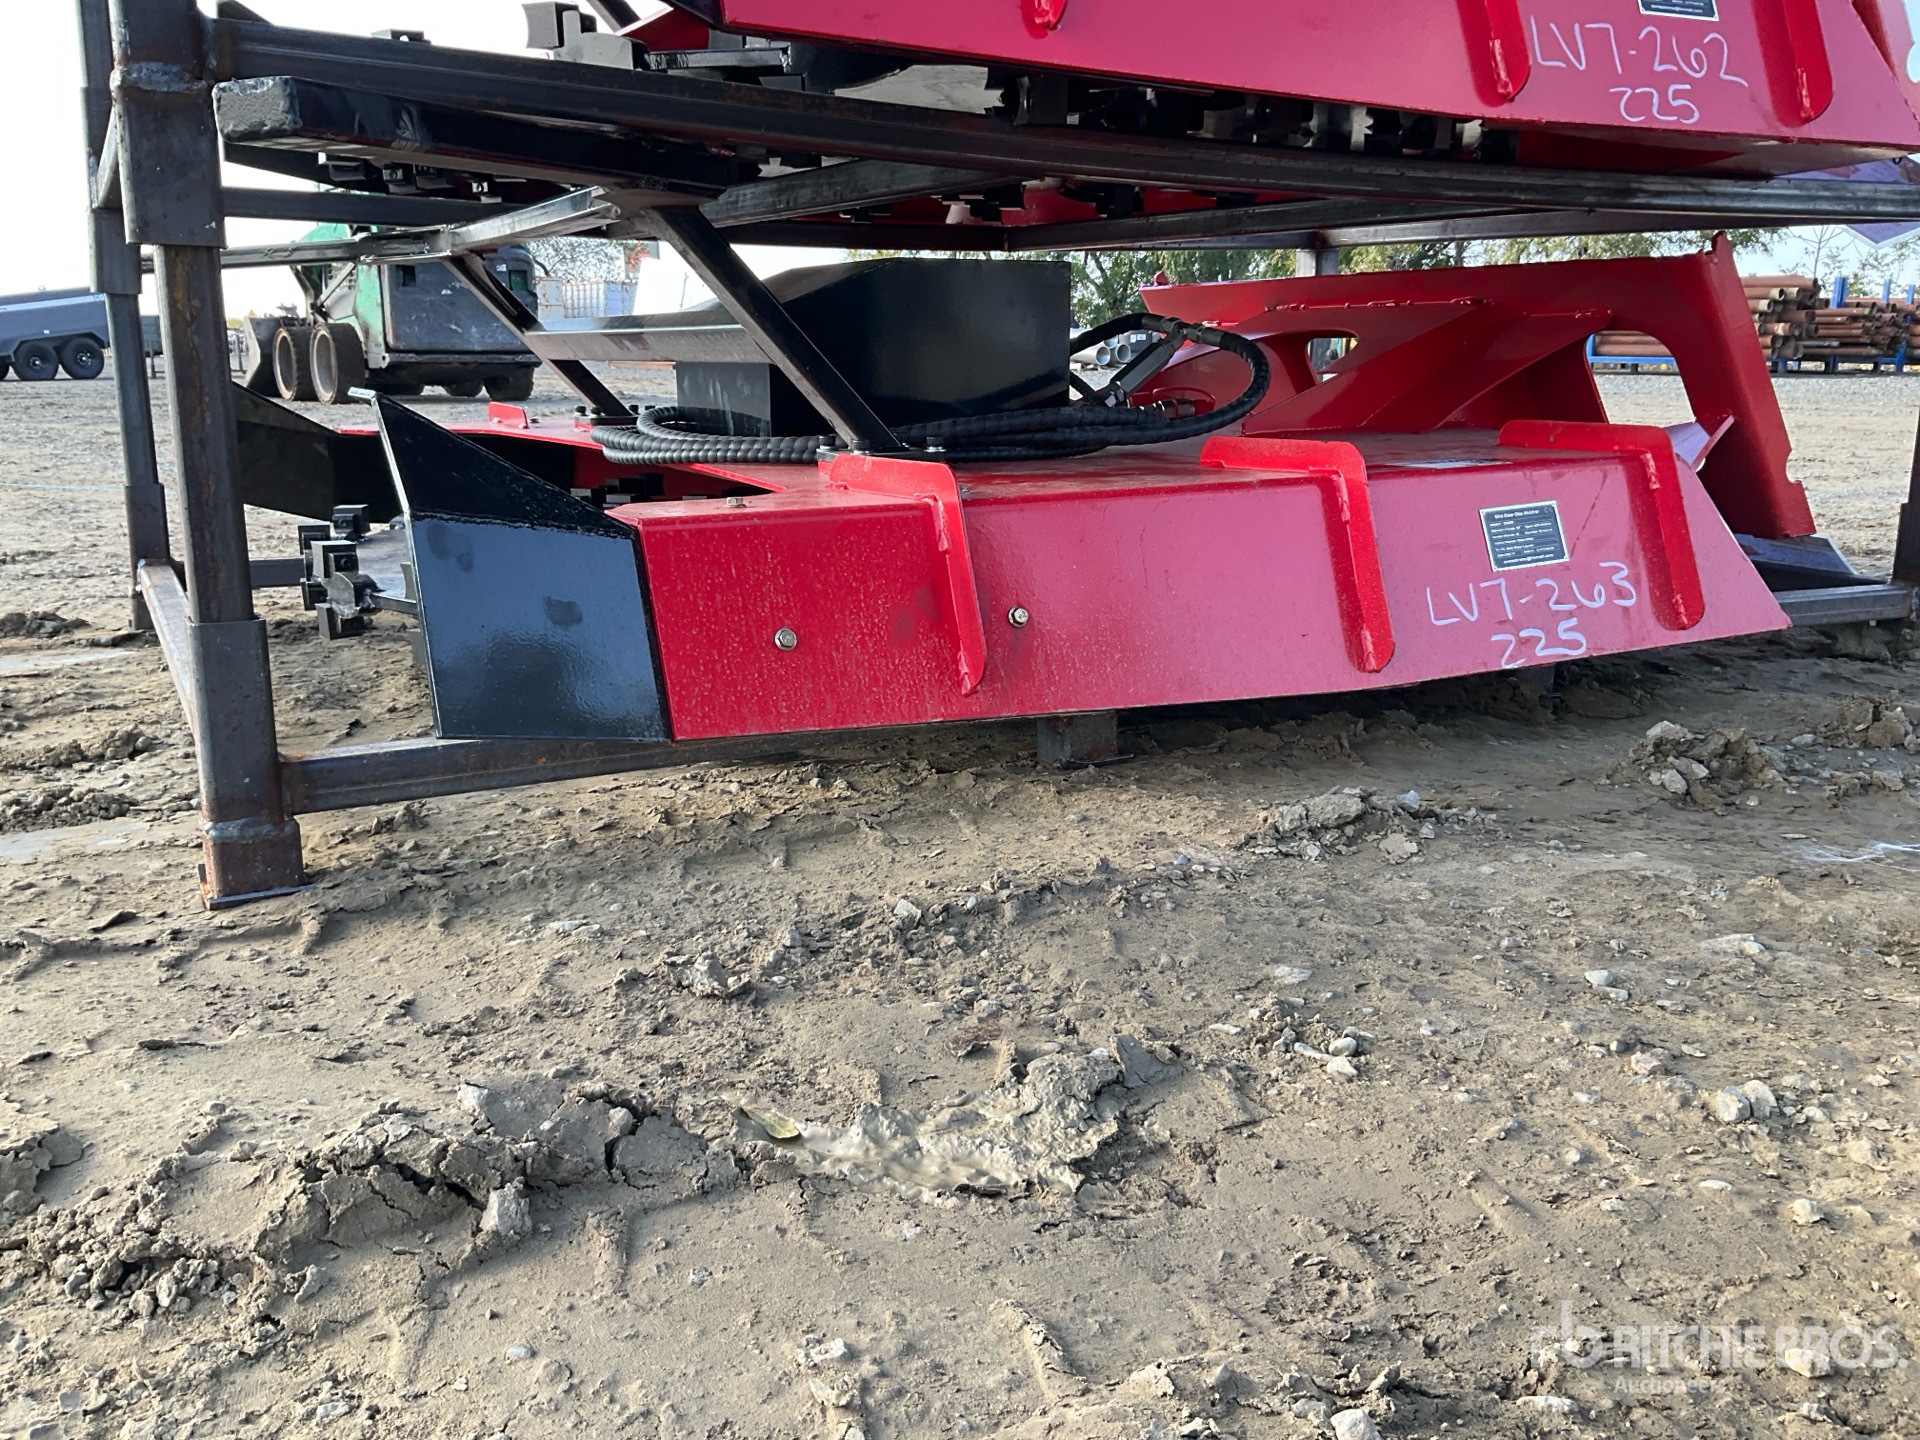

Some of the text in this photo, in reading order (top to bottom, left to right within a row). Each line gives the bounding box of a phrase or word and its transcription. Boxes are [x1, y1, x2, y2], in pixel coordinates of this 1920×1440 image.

[1530, 15, 1748, 87] LV7-262
[1609, 84, 1700, 124] 225
[1426, 561, 1637, 626] LV7-263
[1490, 617, 1587, 669] 225
